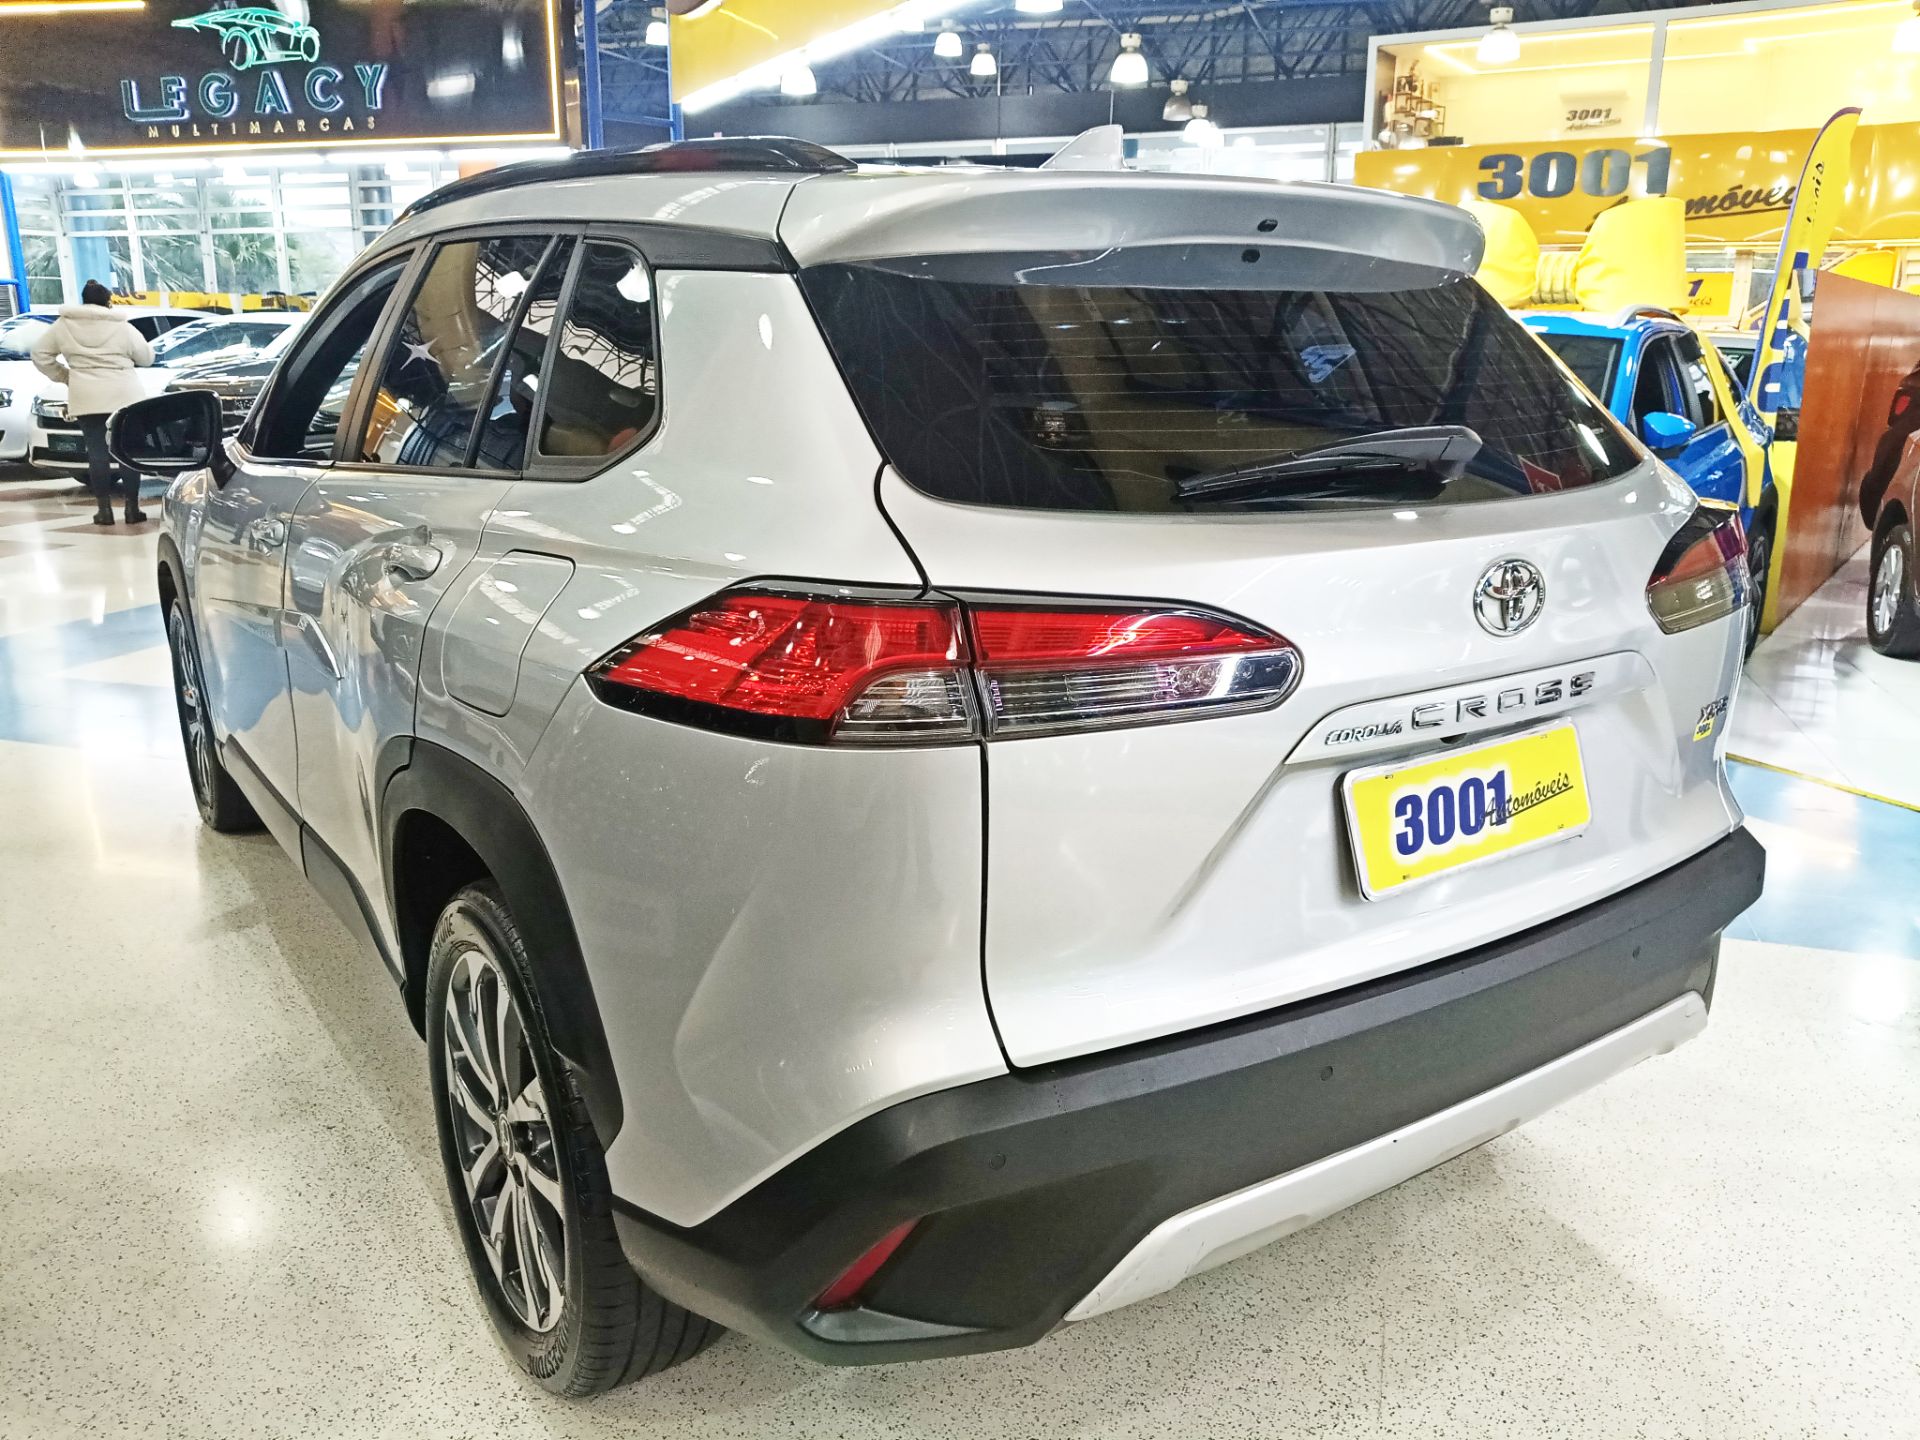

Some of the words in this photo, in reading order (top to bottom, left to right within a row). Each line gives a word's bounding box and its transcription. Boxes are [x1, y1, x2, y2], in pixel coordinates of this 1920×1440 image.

[121, 64, 388, 121] LEGACY
[1566, 107, 1612, 121] 3001
[147, 116, 376, 139] MULTIMARCAS
[1477, 147, 1672, 200] 3001
[1324, 720, 1403, 746] COROLLA
[1411, 671, 1596, 731] CROSS
[1394, 769, 1507, 855] 3001
[1481, 772, 1573, 826] Automóveis
